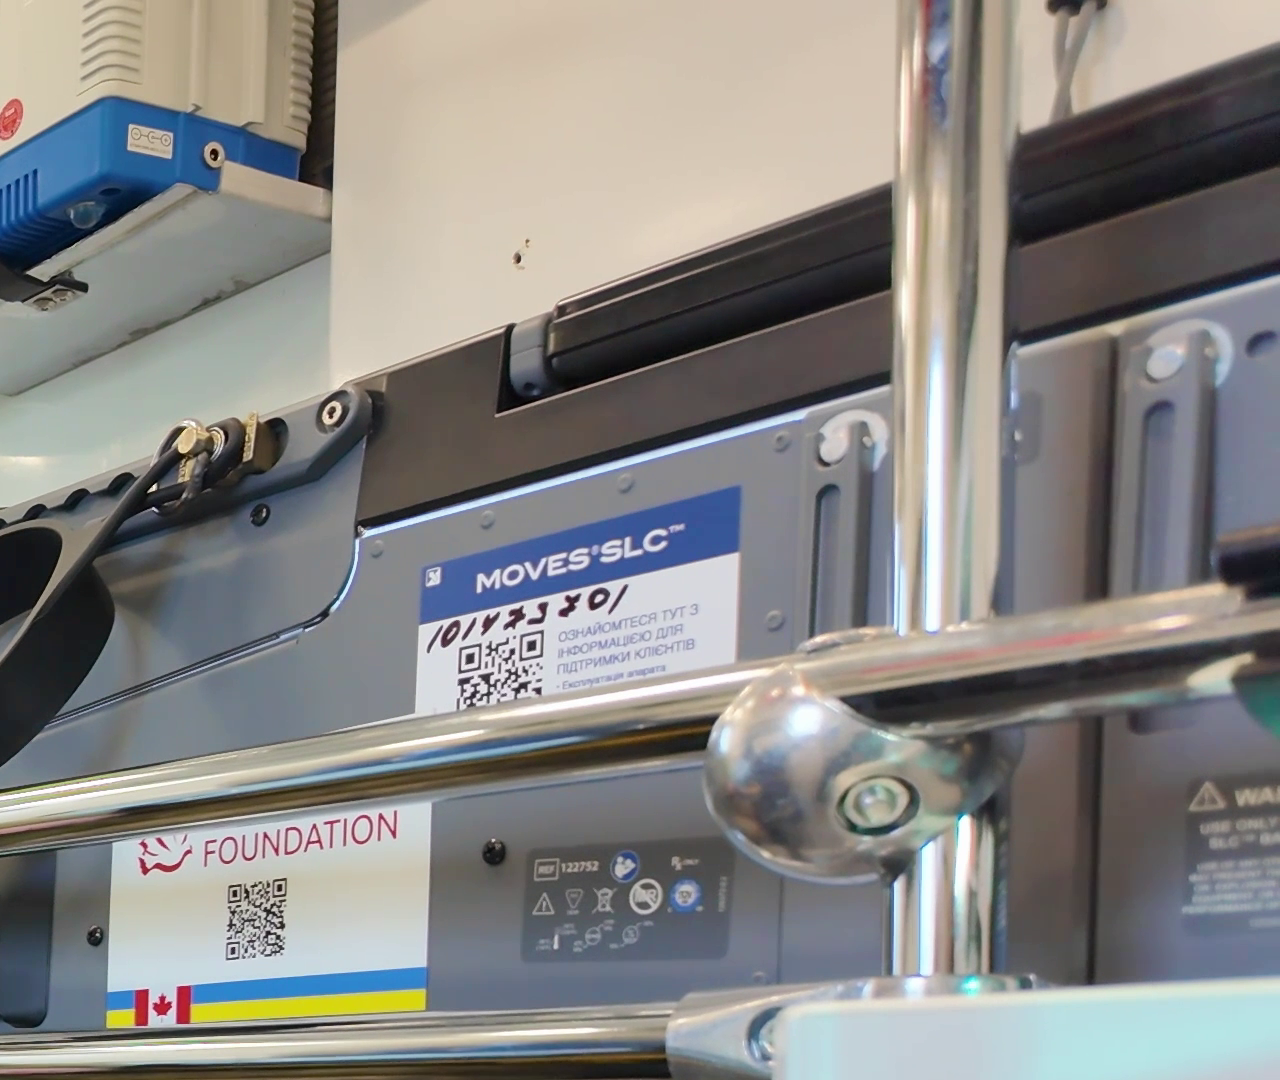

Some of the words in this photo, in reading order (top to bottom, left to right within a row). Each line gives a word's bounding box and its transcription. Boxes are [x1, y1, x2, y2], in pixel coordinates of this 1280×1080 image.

[557, 629, 652, 659] ІНФОРМАЦІЄЮ
[655, 623, 684, 641] ДЛЯ
[558, 612, 657, 643] ОЗНАЙОМТЕСЯ
[661, 605, 686, 622] ТУТ
[556, 650, 631, 675] ПІДТРИМКИ
[634, 638, 696, 661] КЛІЄНТІВ
[202, 809, 399, 868] FOUNDATION
[561, 860, 600, 873] 122752
